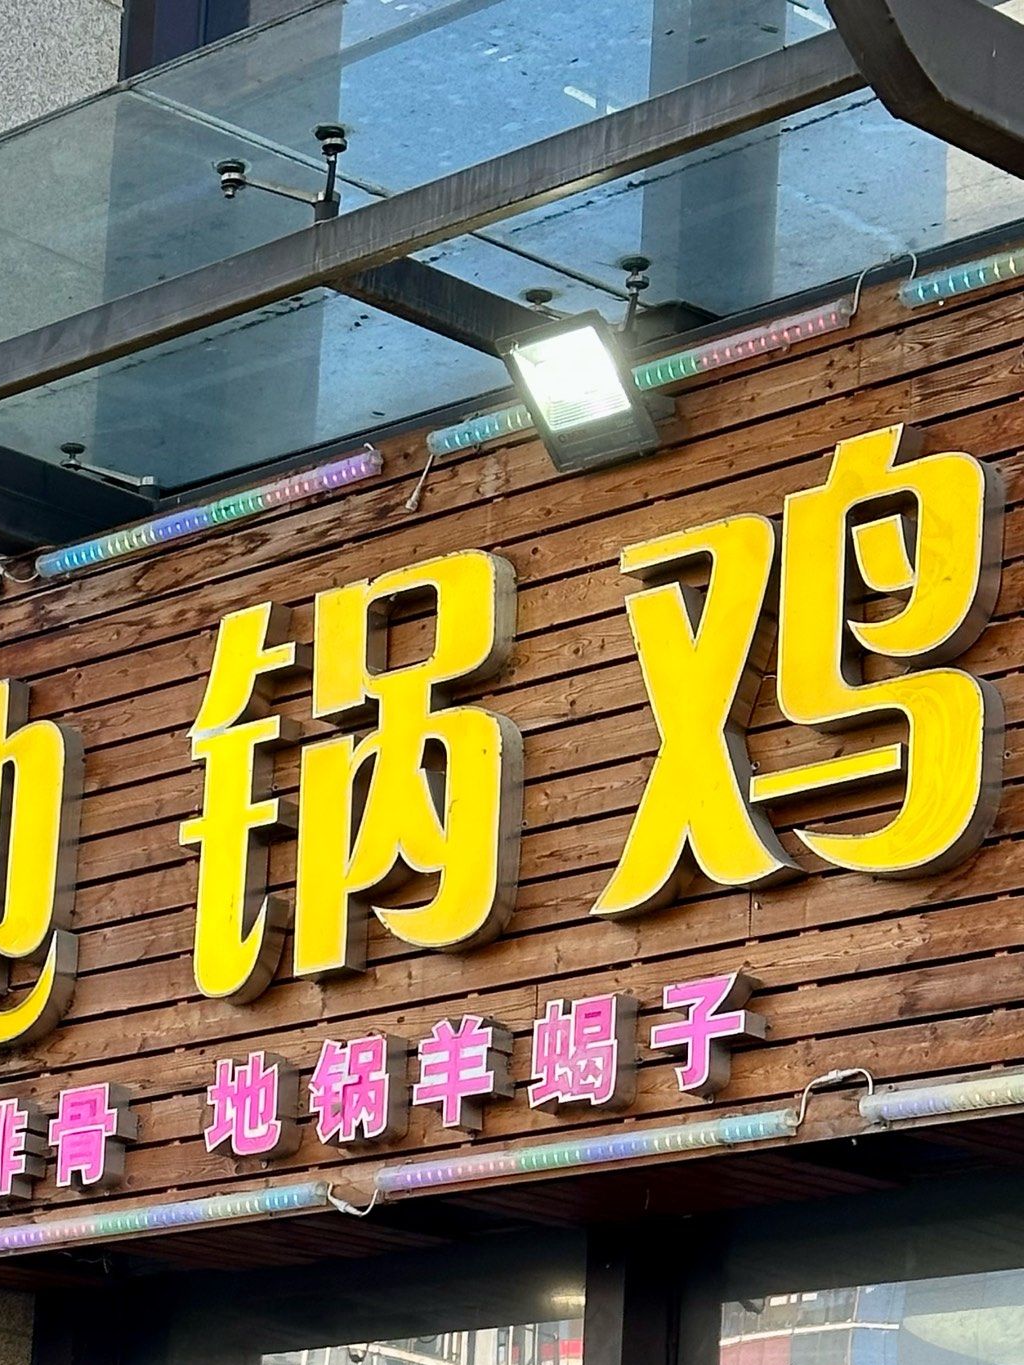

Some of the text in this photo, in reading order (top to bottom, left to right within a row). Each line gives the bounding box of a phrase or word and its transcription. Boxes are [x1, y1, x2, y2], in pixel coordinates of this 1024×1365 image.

[205, 973, 746, 1156] 地锅羊蝎子
